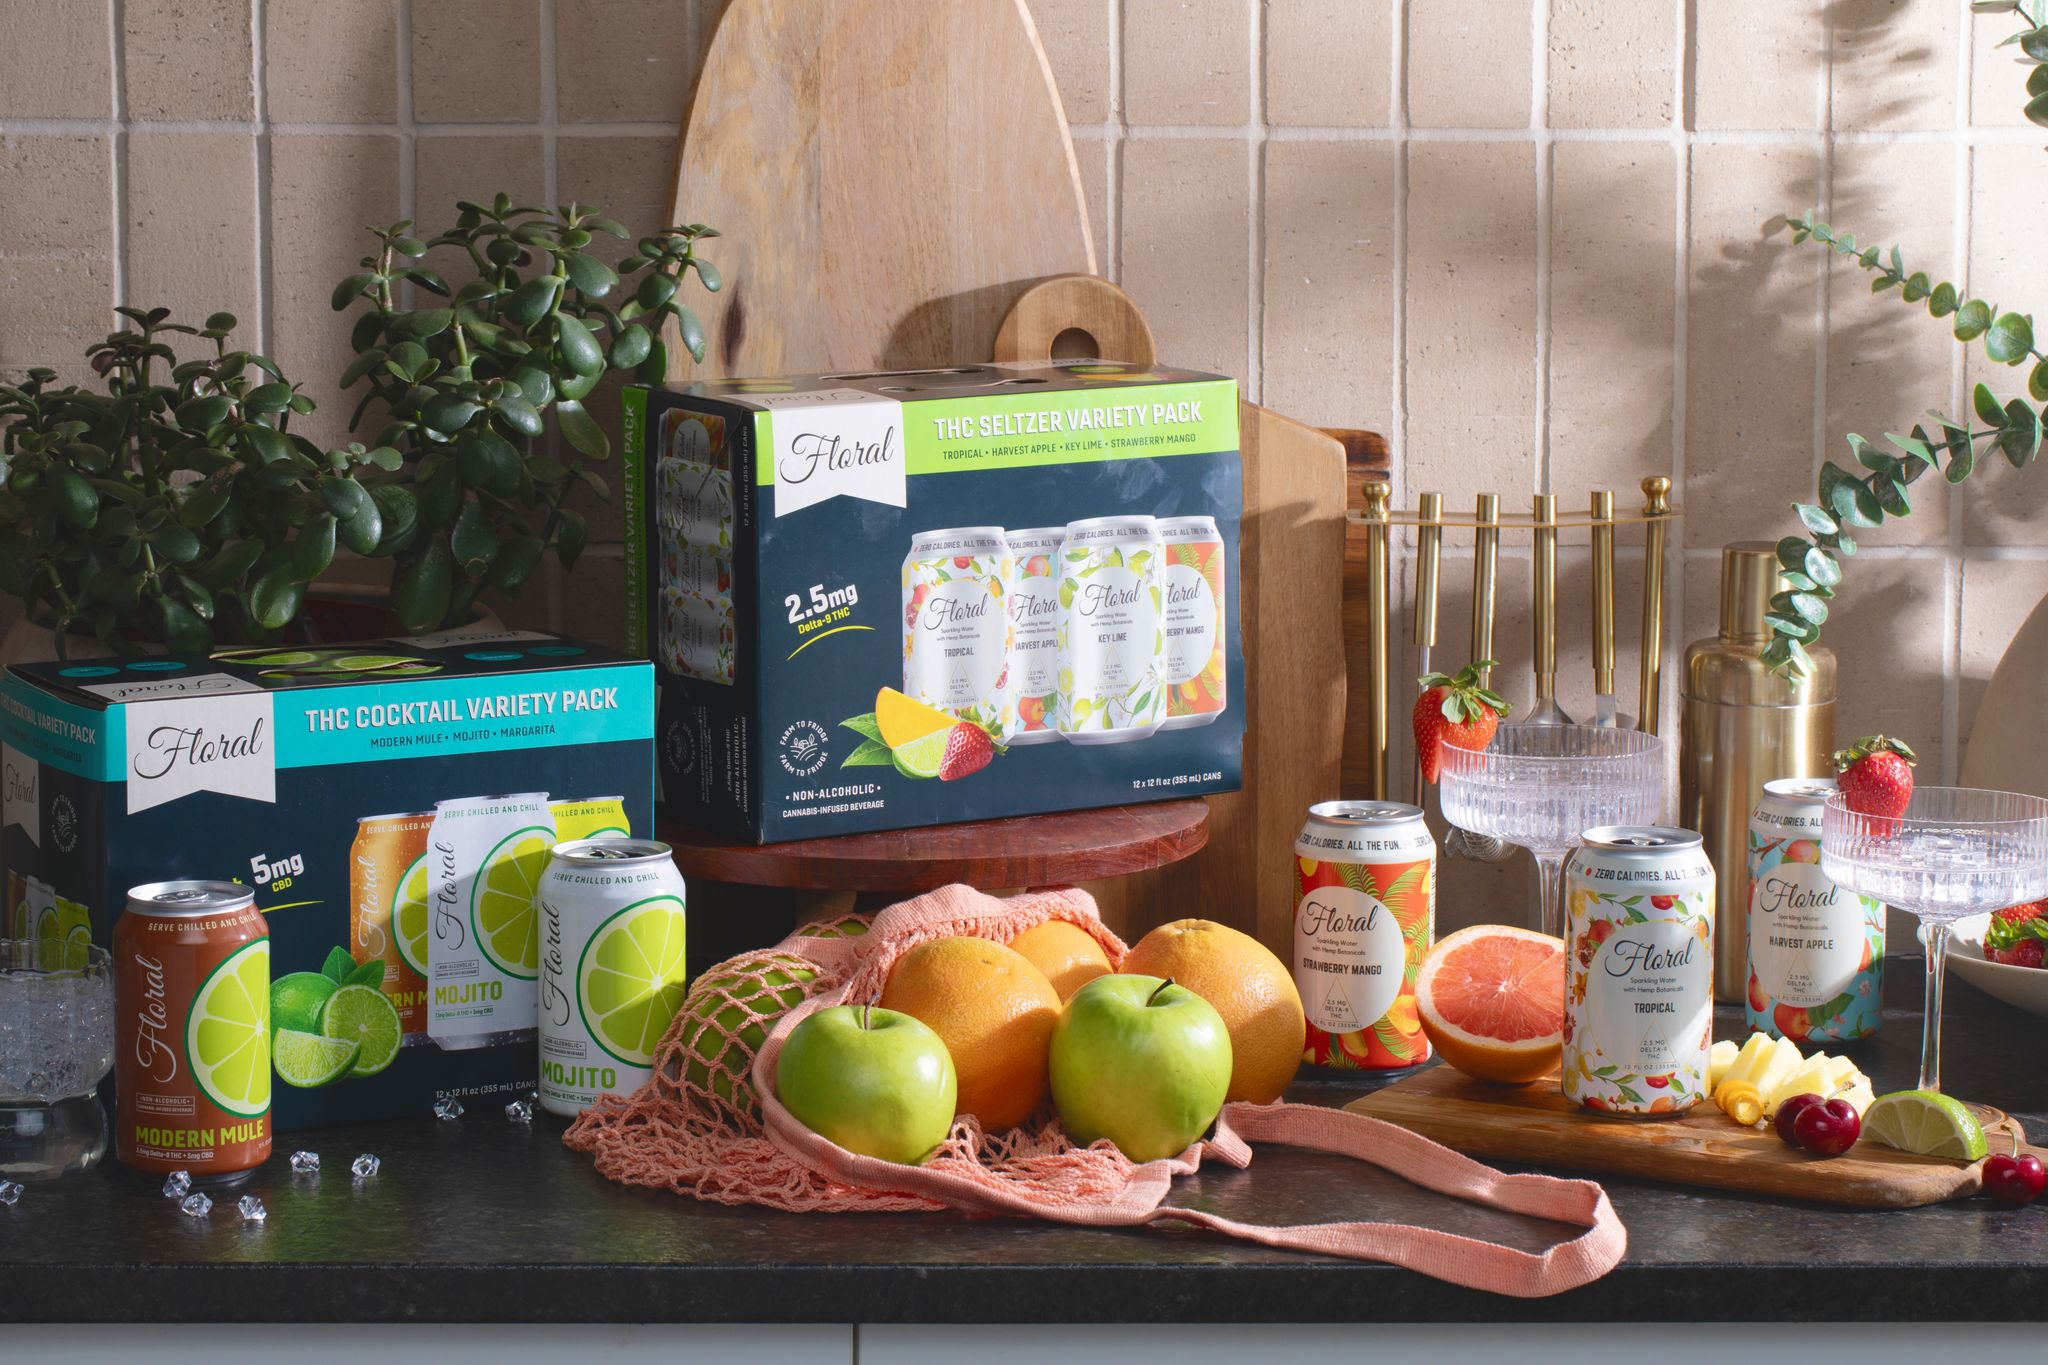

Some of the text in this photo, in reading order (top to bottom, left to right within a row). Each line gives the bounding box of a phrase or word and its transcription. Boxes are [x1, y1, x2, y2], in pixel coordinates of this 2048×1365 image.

[933, 400, 1203, 441] THC SELTZER VARIETY PACK
[779, 424, 894, 485] Floral
[942, 432, 1197, 461] TROPICAL HARVEST APPLE KEY LIME STRAWBERRY MANGO
[623, 403, 637, 626] SELTZER VARIETY PACK
[1116, 528, 1128, 537] ALL
[1179, 528, 1190, 536] ALL
[918, 542, 932, 553] ZERO
[963, 540, 975, 548] ALL
[784, 583, 859, 625] 2.5mg
[1078, 579, 1141, 617] Floral
[797, 606, 851, 635] Delta-9 THC
[923, 593, 988, 631] Floral
[1098, 632, 1127, 643] KEY LIME
[1185, 625, 1205, 635] MANGO
[944, 647, 974, 658] TROPICAL
[304, 686, 618, 732] THC COCKTAIL VARIETY PACK
[37, 711, 69, 737] VARIETY
[70, 723, 96, 745] PACK
[371, 724, 556, 749] MODERN MULE MOJITO MARGARITA
[779, 720, 829, 746] FARM TO FRIDGE
[134, 717, 264, 780] Floral
[779, 751, 829, 777] FARM TO FRIDGE
[5, 763, 36, 805] Floral
[792, 783, 875, 802] NON-ALCOHOLIC
[1133, 780, 1141, 789] 12
[1147, 778, 1155, 787] 12
[1155, 778, 1162, 786] fl
[1162, 778, 1171, 786] oz
[1172, 775, 1188, 786] (355
[1202, 771, 1222, 781] CANS
[444, 803, 539, 819] SERVE CHILLED AND CHILL
[580, 806, 615, 816] AND CHILL
[782, 799, 885, 818] CANNABIS-INFUSED BEVERAGE
[1757, 811, 1807, 827] ZERO CALORIES.
[366, 825, 386, 834] SERVE
[387, 822, 418, 833] CHILLED
[1311, 834, 1345, 850] CALORIES.
[1347, 840, 1364, 851] ALL
[1366, 840, 1382, 851] THE
[1383, 840, 1402, 851] FUN.
[250, 853, 305, 885] 5mg
[553, 872, 659, 885] SERVE CHILLED AND CHILL
[1594, 868, 1615, 881] ZERO
[1617, 870, 1663, 881] CALORIES.
[1664, 870, 1681, 881] ALL
[271, 876, 293, 893] CBD
[435, 841, 465, 951] Floral
[1759, 877, 1840, 913] Floral
[358, 855, 386, 957] Floral
[1301, 900, 1379, 936] Floral
[148, 913, 257, 932] SERVE CHILLED AND CHILL
[1317, 936, 1358, 947] Sparkling Water
[1769, 935, 1834, 950] HARVEST APPLE
[541, 900, 571, 1027] Floral
[1303, 957, 1382, 976] STRAWBERRY MANGO
[1604, 936, 1694, 978] Floral
[1630, 976, 1658, 985] Sparkling
[1637, 986, 1655, 994] Hemp
[1656, 985, 1684, 993] Botanicals
[435, 981, 503, 1006] MOJITO
[135, 953, 176, 1083] Floral
[1634, 1002, 1676, 1014] TROPICAL
[541, 1058, 616, 1089] MOJITO
[436, 1089, 445, 1099] 12
[452, 1088, 461, 1097] 12
[461, 1087, 468, 1096] fl
[469, 1087, 479, 1095] oz
[480, 1084, 498, 1095] (355
[515, 1080, 537, 1090] CANS
[136, 1125, 215, 1148] MODERN
[220, 1119, 264, 1146] MULE
